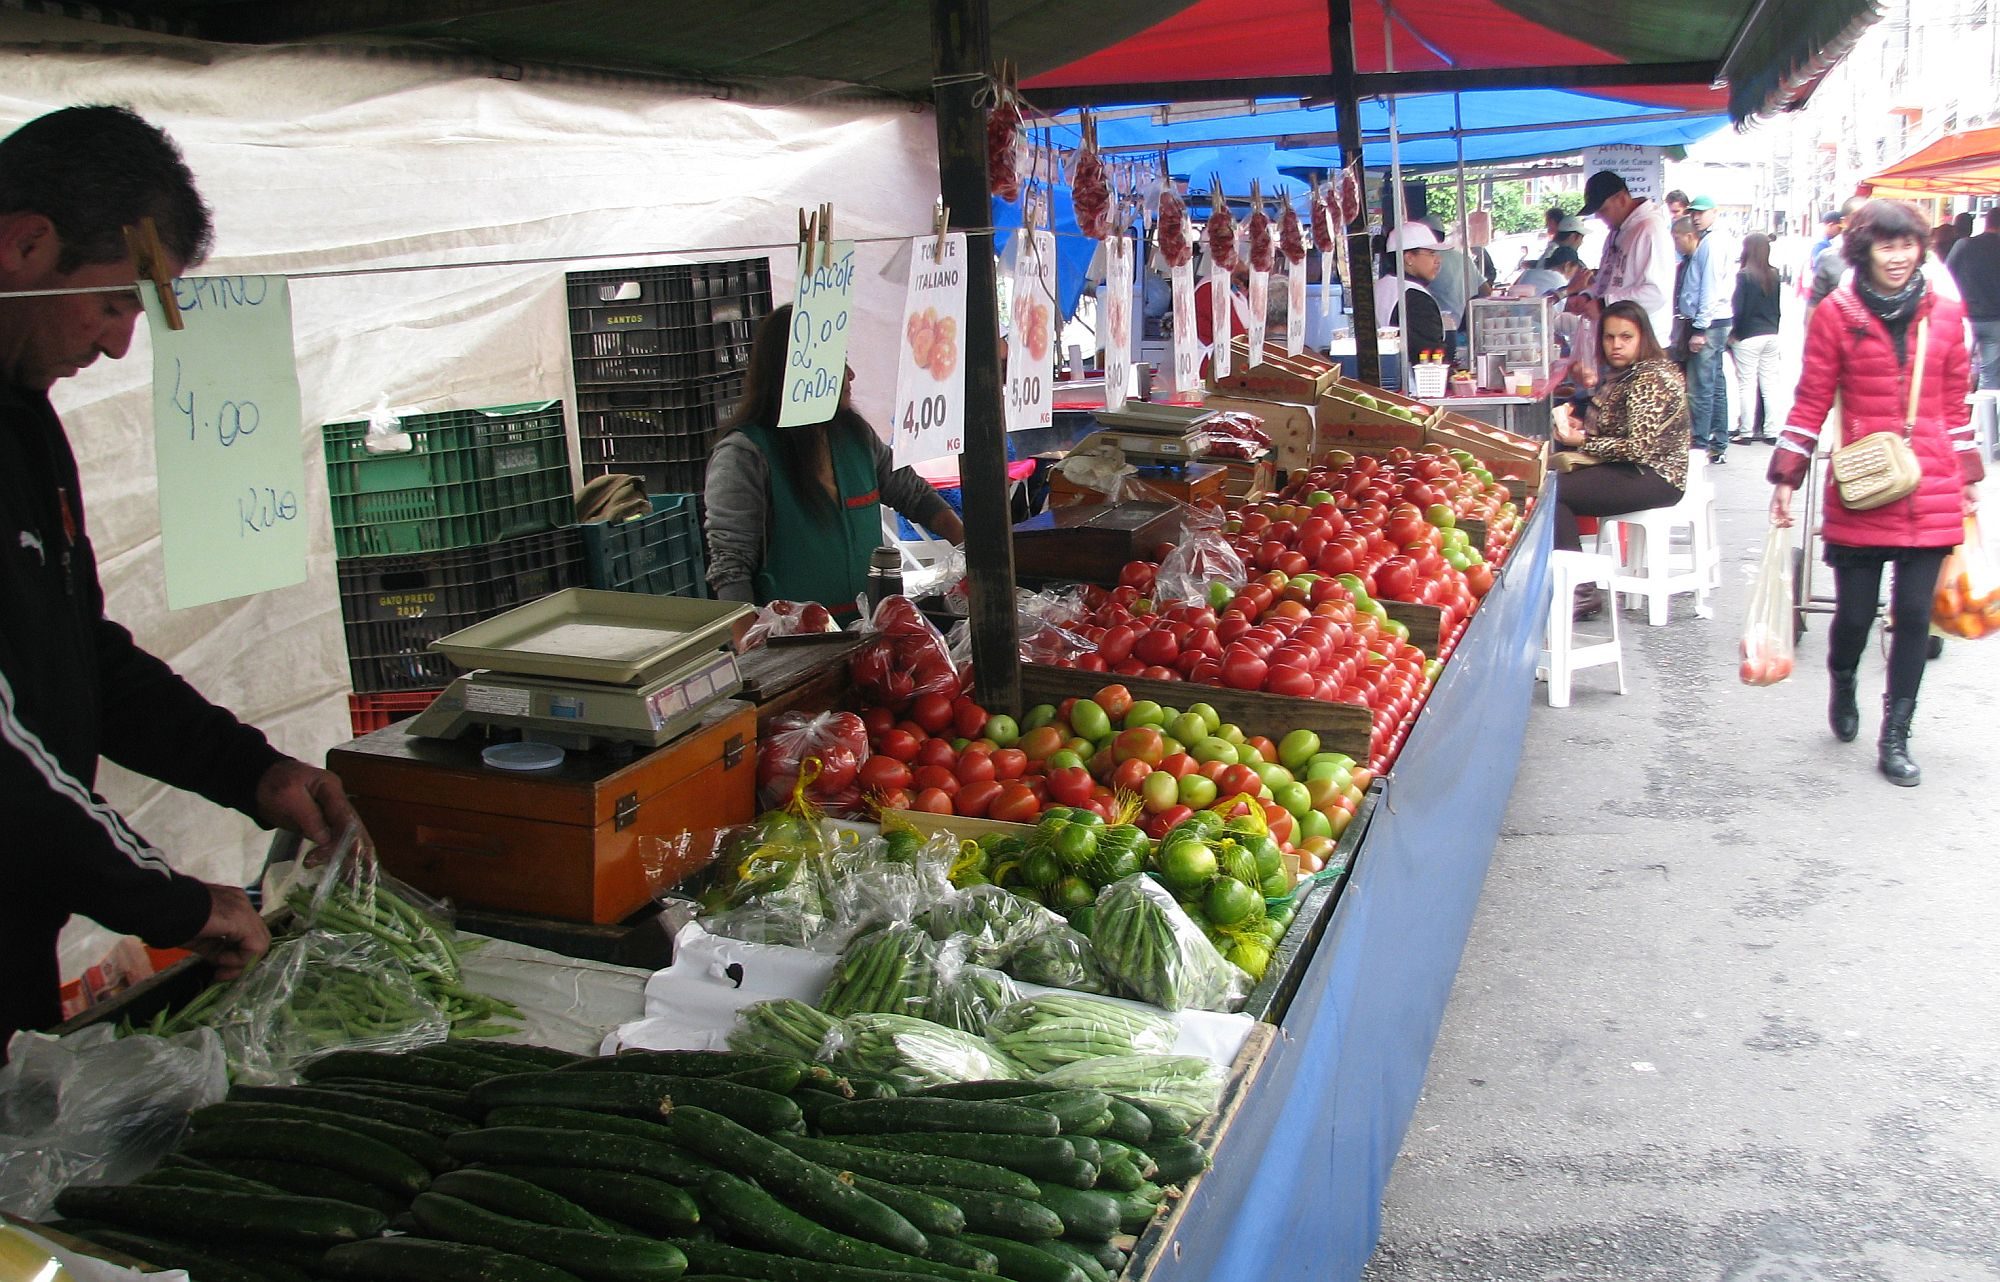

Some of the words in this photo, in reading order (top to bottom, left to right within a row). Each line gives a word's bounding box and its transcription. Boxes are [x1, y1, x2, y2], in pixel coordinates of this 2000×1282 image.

[915, 270, 959, 291] ITALIANO
[607, 314, 643, 325] SANTOS
[792, 310, 847, 369] 2.00
[792, 367, 838, 403] CADA
[1011, 376, 1041, 413] 5,00
[174, 357, 259, 447] 4.00
[903, 394, 947, 439] 4,00
[1039, 412, 1051, 424] KG
[946, 437, 961, 452] KG
[379, 595, 402, 606] GATO
[404, 593, 436, 604] PRETO
